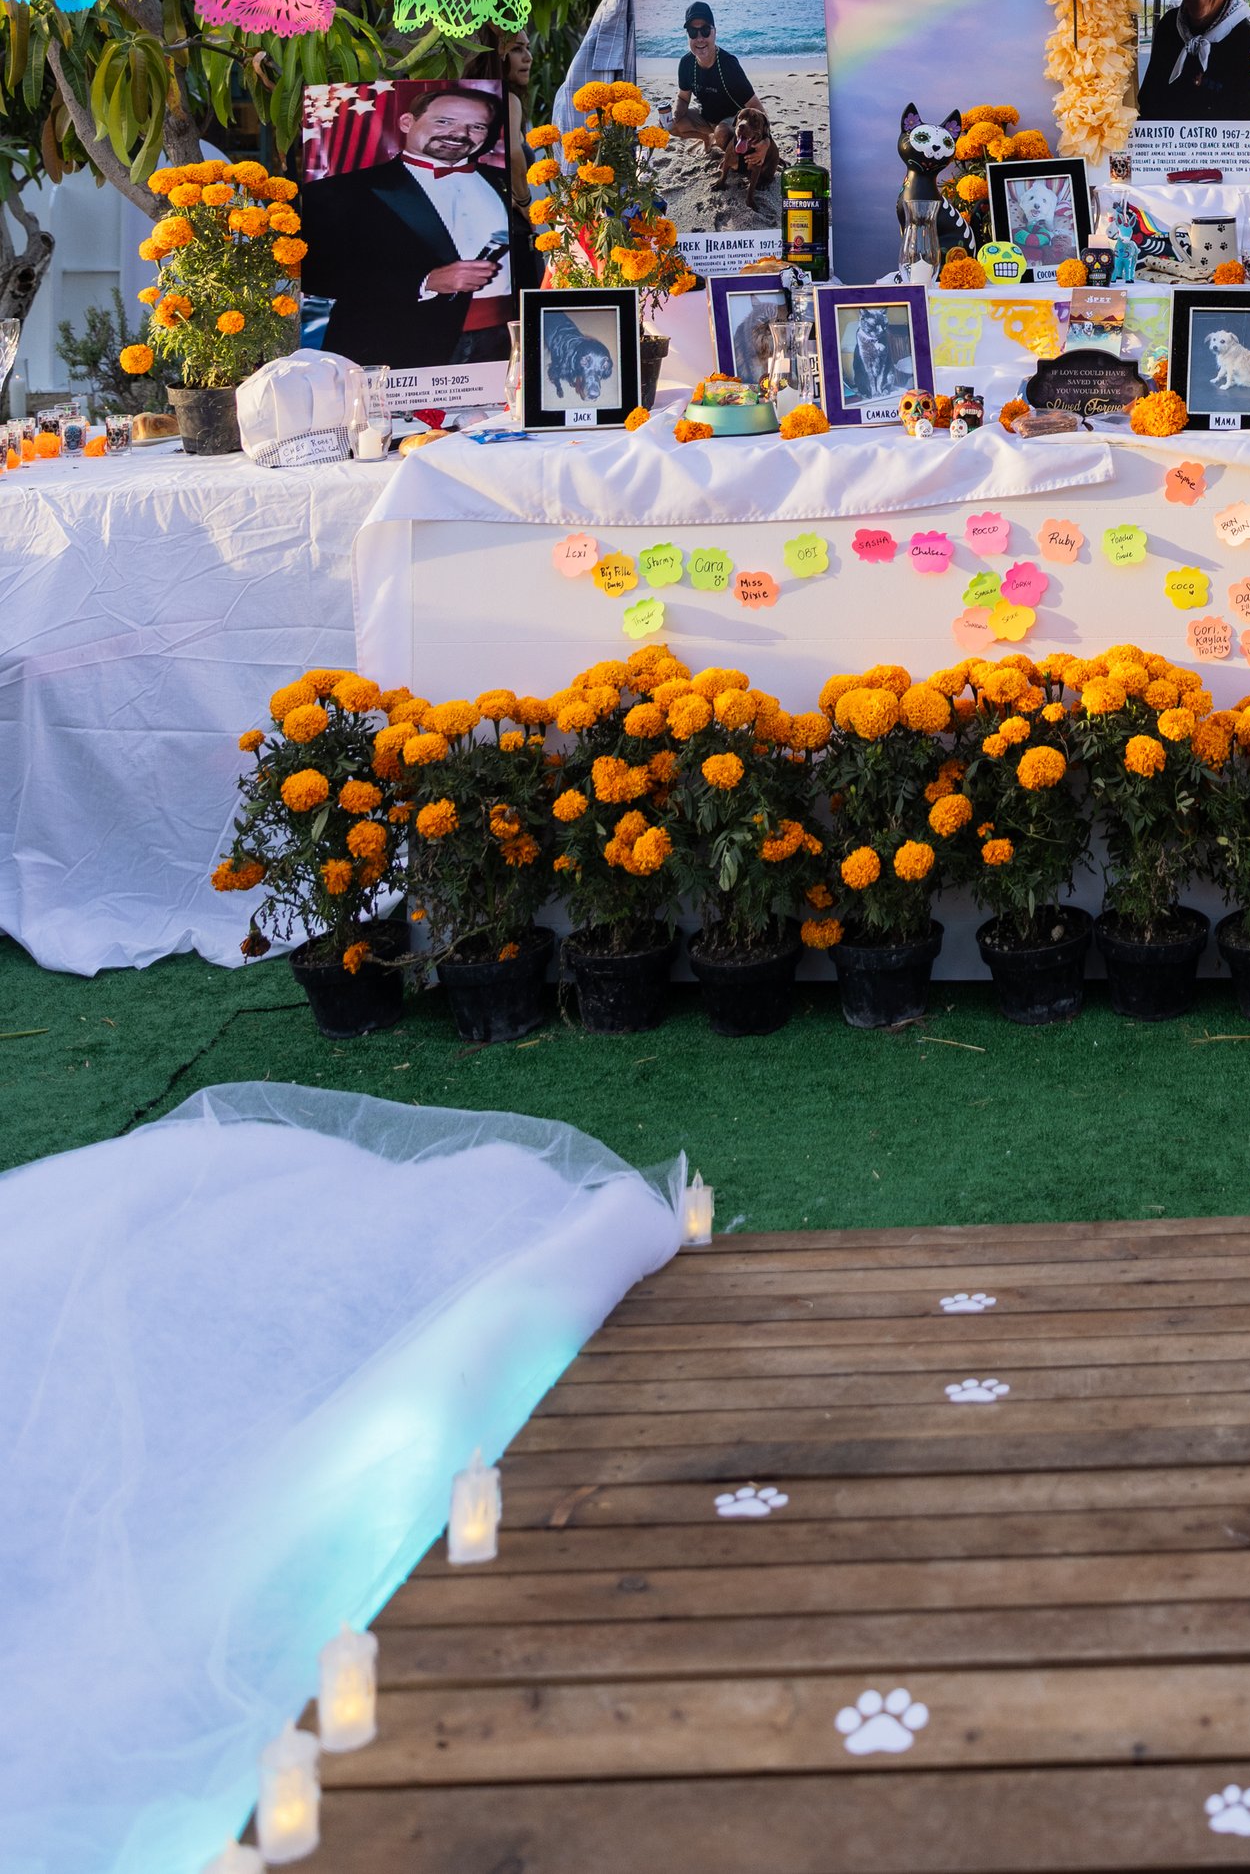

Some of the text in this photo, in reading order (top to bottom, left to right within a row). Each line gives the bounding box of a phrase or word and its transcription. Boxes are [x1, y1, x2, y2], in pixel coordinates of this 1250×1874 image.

[1180, 126, 1218, 139] CASTRO
[783, 200, 820, 208] BECHEROVKA
[676, 239, 755, 253] IREK HRABANEK
[432, 375, 470, 387] 1951-2025
[1047, 398, 1125, 416] Lived Forever
[573, 412, 591, 423] JACK
[1215, 417, 1236, 426] MAMA
[283, 443, 304, 457] CHEF
[858, 536, 889, 549] SASHA
[1048, 532, 1076, 551] Ruby
[798, 547, 818, 561] OBI
[647, 556, 674, 569] Stormy
[695, 557, 724, 573] Cara
[600, 567, 612, 580] Big
[740, 579, 762, 588] Miss
[741, 590, 768, 601] Dixie
